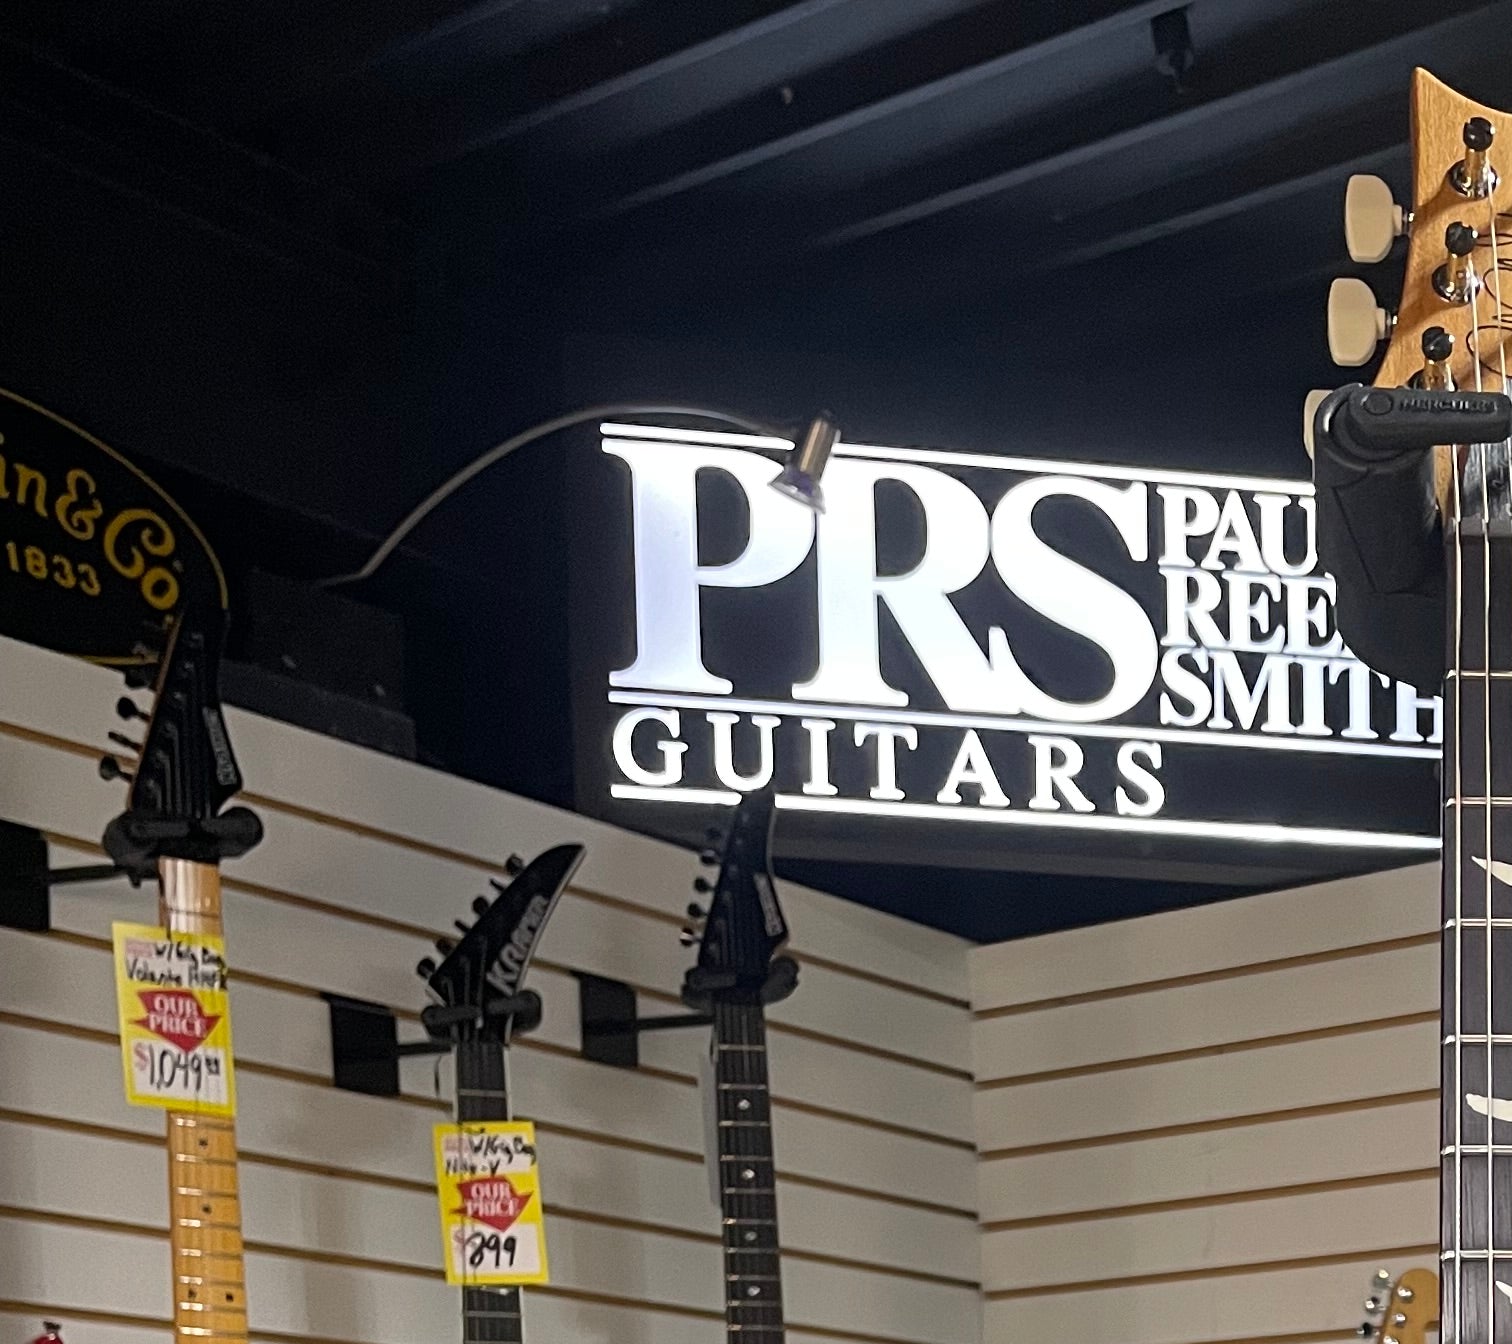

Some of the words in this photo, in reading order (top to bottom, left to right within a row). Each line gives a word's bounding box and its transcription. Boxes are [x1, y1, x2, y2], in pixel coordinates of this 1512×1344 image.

[1156, 486, 1317, 576] PAU
[6, 541, 101, 597] 1833
[602, 438, 1159, 722] PRS
[1160, 568, 1356, 657] REE
[1160, 648, 1443, 743] SMITH
[612, 707, 1165, 817] GUITARS
[150, 1014, 208, 1038] PRICE
[153, 996, 199, 1018] OUR
[466, 1197, 518, 1217] PRICE
[471, 1182, 511, 1200] OUR
